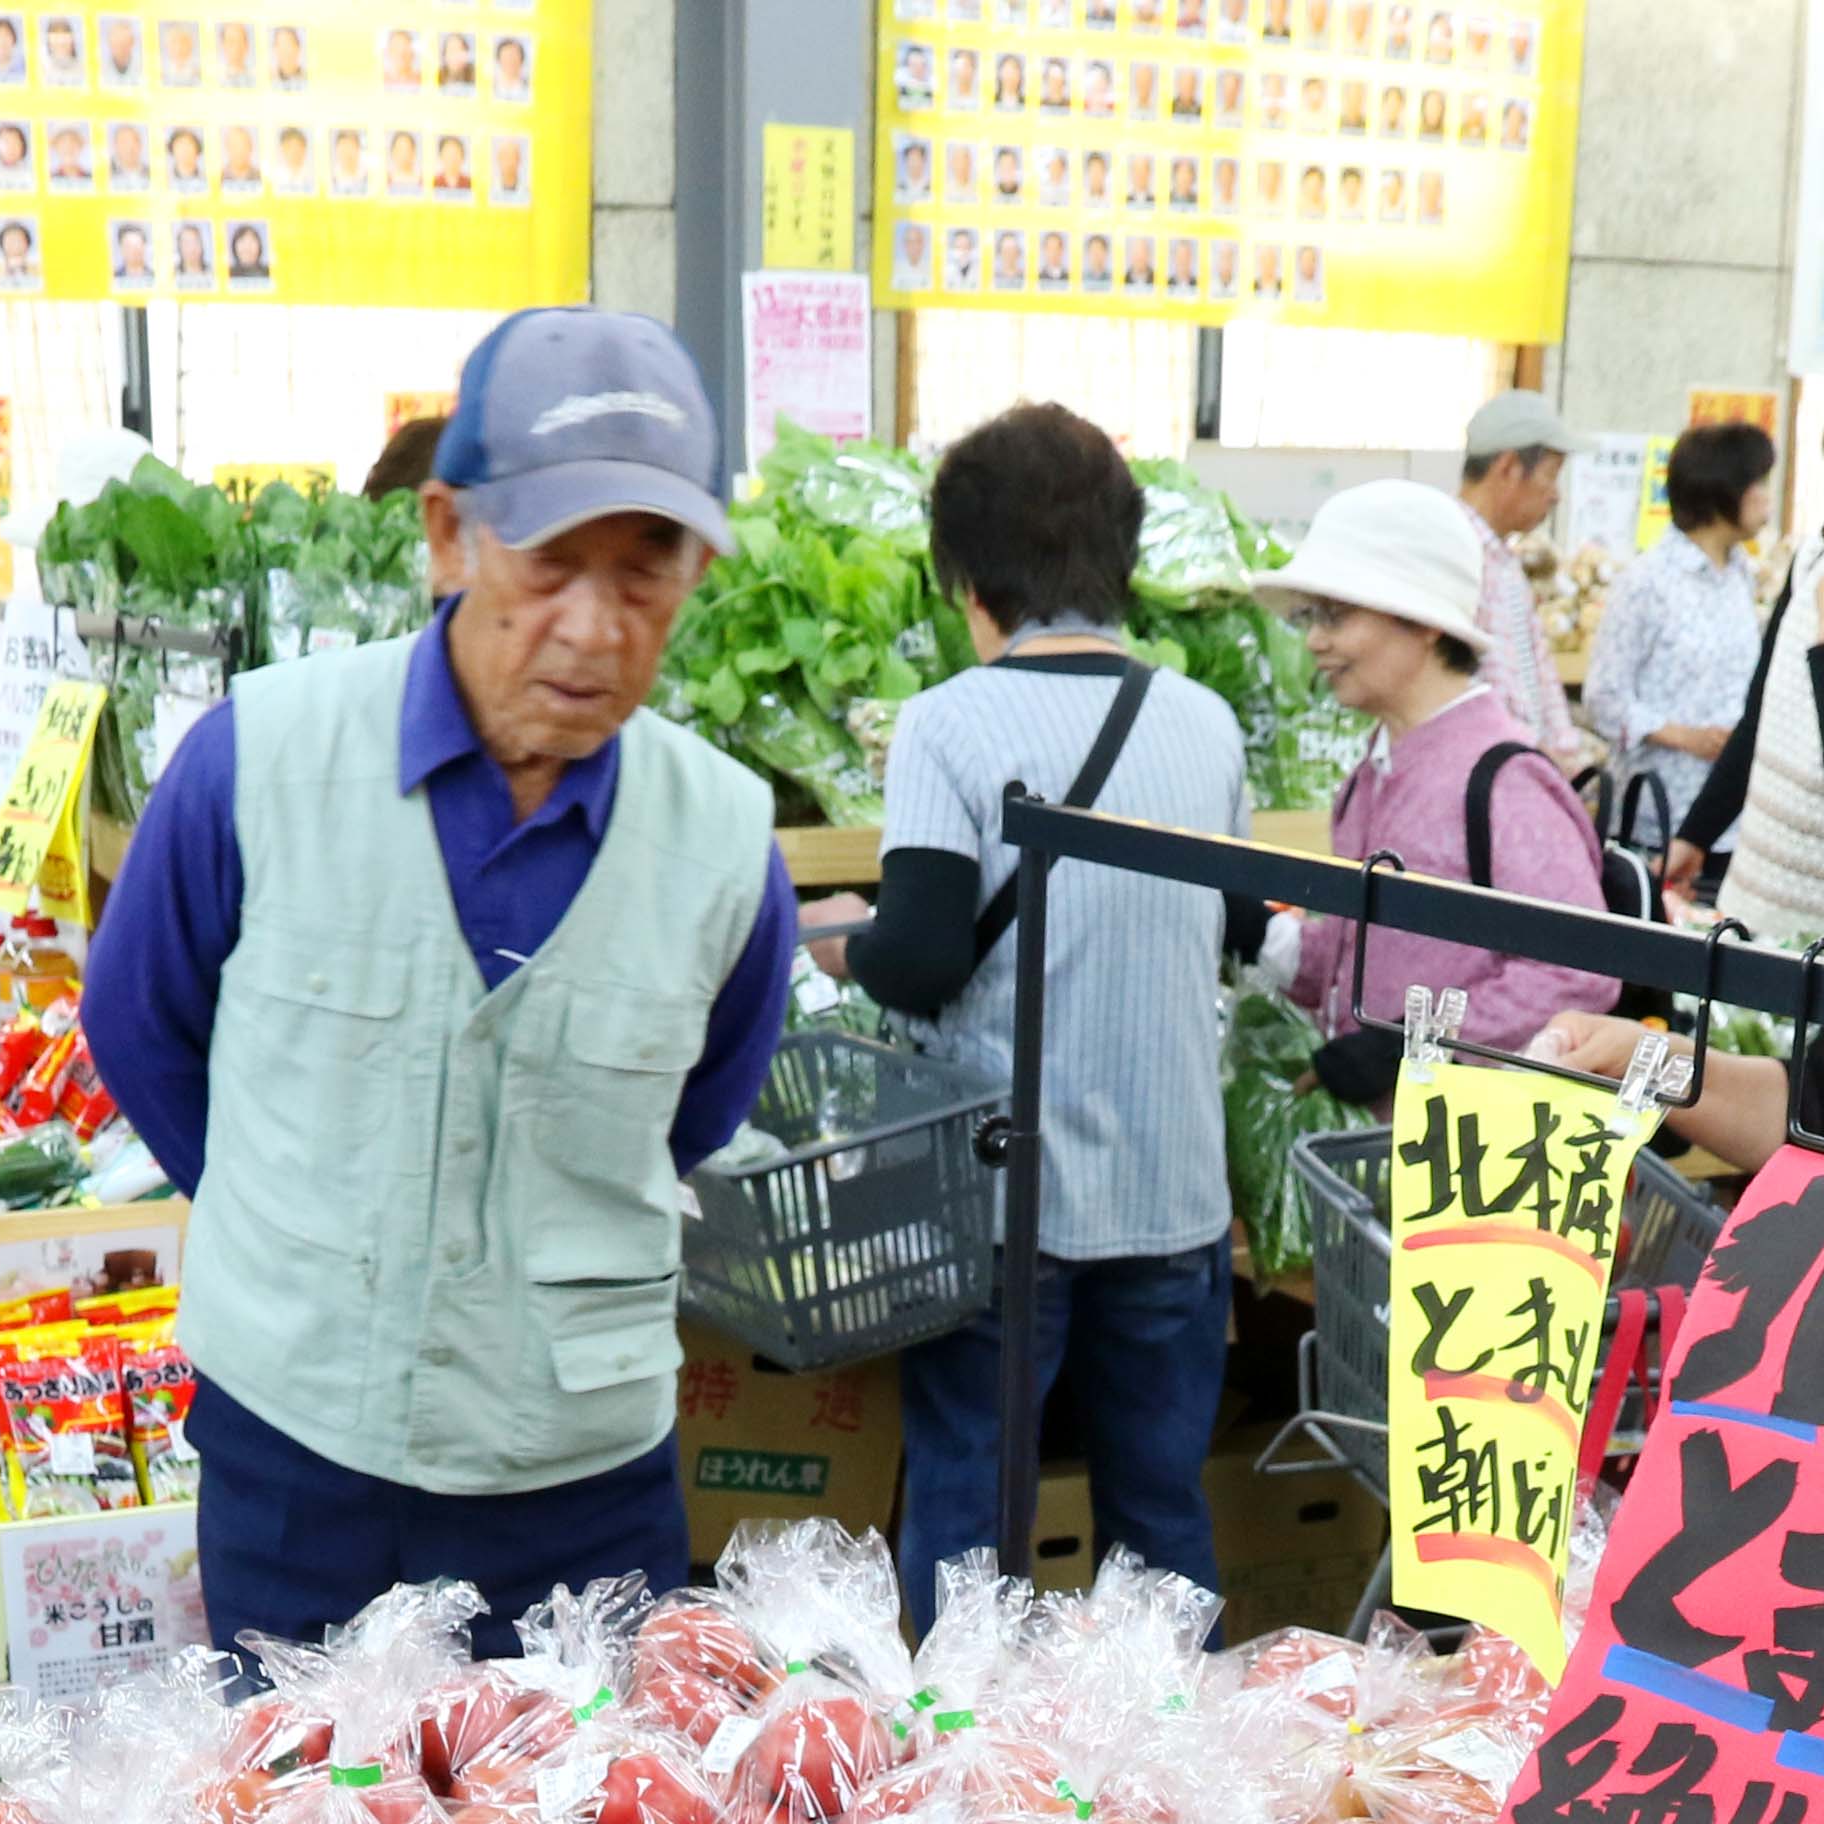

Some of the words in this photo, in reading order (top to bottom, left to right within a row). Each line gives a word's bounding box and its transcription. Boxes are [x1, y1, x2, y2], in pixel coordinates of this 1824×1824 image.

[1411, 1276, 1590, 1411] とまと
[99, 1617, 154, 1648] 甘酒
